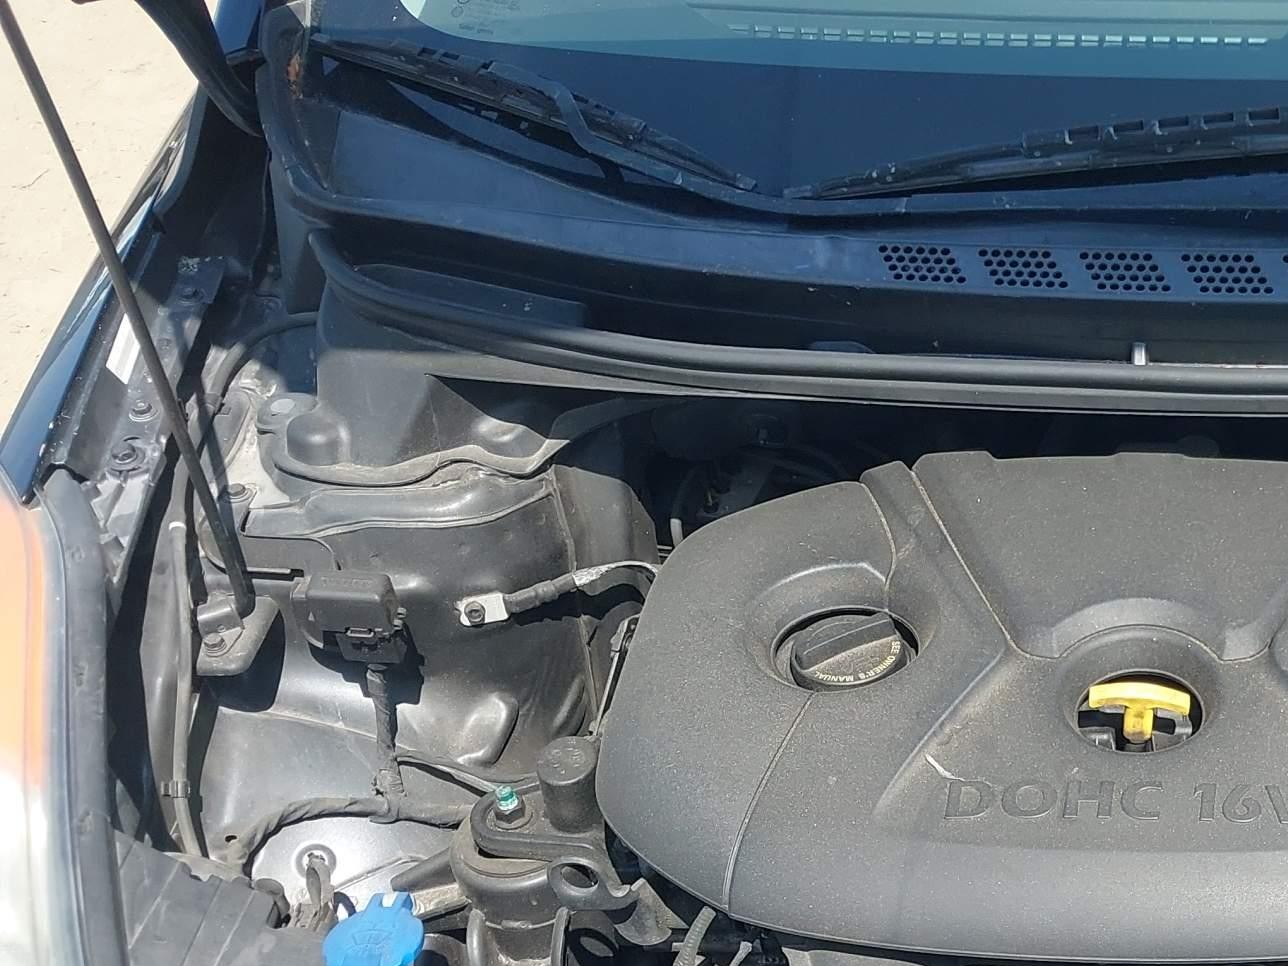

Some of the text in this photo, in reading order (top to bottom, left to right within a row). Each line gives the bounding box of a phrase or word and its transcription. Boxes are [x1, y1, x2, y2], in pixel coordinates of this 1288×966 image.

[891, 640, 901, 655] SEE
[814, 670, 854, 682] MANUAL
[943, 779, 1165, 821] DOHC
